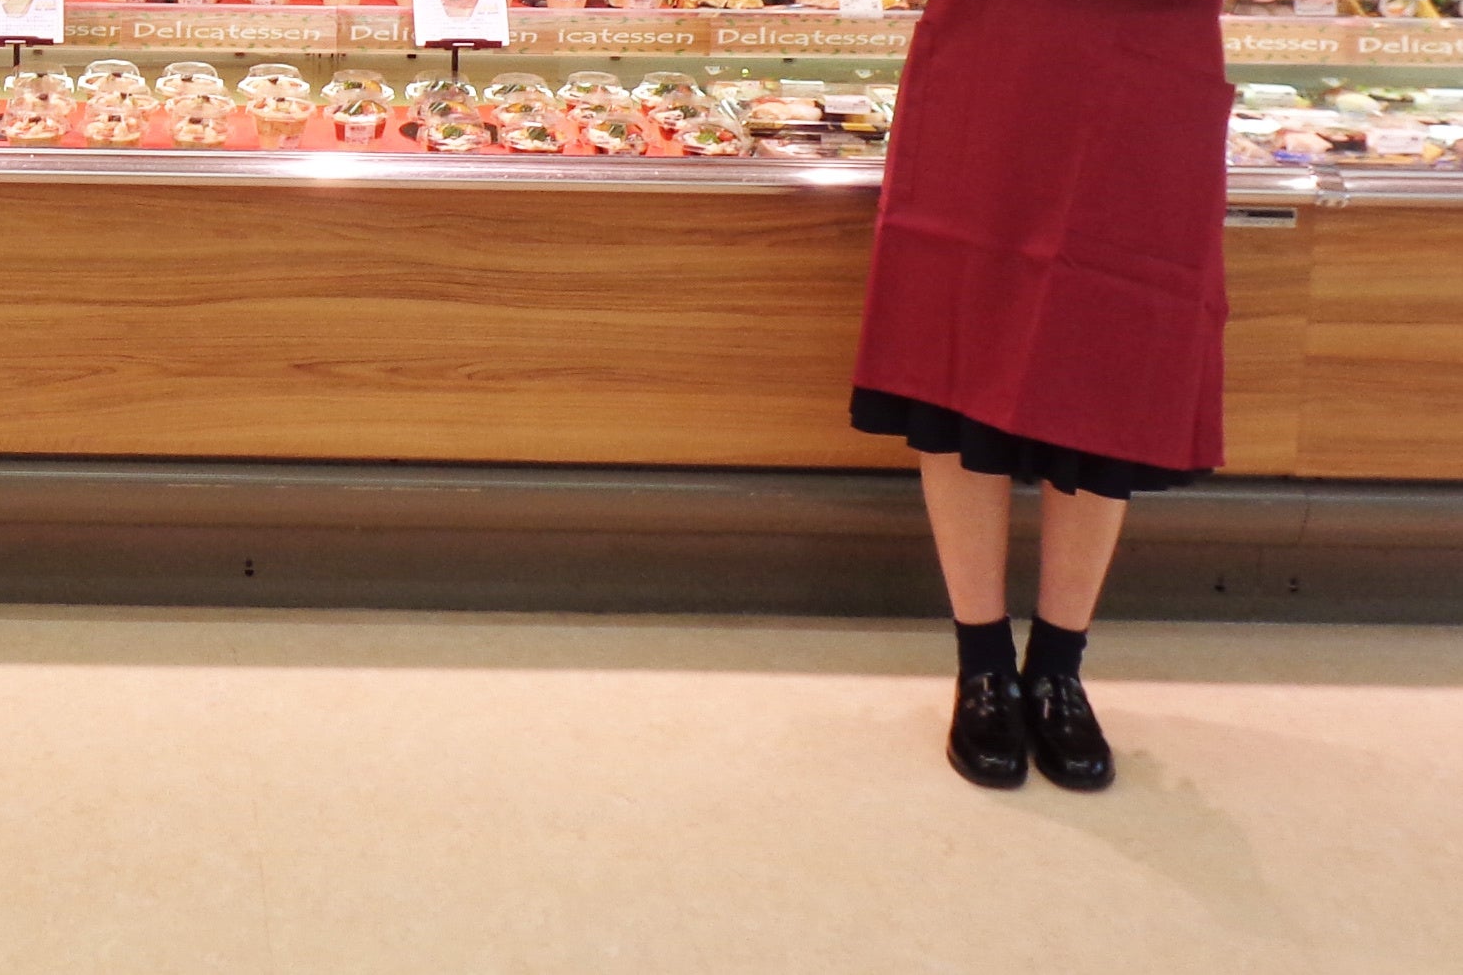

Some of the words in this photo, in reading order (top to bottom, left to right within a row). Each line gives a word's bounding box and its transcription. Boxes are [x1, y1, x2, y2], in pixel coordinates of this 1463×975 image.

[133, 21, 320, 41] Delicatessen
[558, 27, 694, 46] icatessen
[718, 26, 907, 46] Delicatessen
[1225, 34, 1338, 52] atessen
[1358, 36, 1463, 54] Delicat
